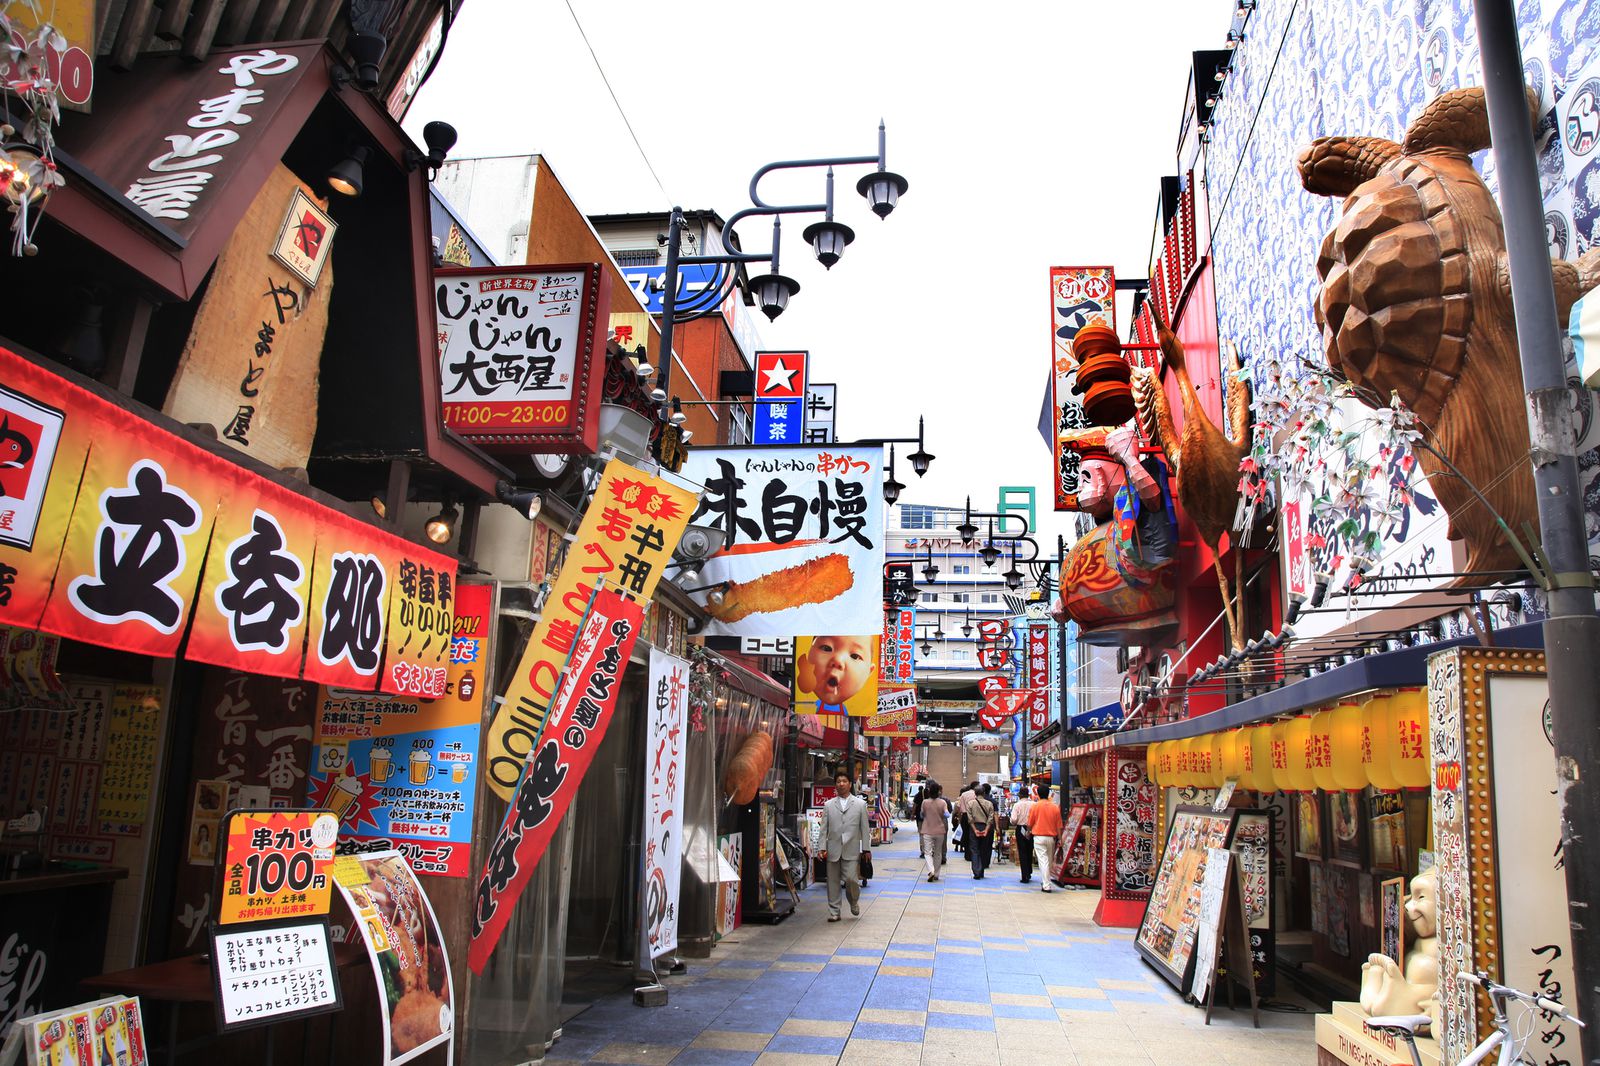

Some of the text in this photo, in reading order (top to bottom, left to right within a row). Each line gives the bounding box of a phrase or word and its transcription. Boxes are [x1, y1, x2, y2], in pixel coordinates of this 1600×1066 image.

[124, 50, 299, 220] やまと屋
[481, 279, 535, 292] 新世界名物
[538, 289, 580, 303] どて焼き
[542, 275, 577, 288] 串かつ
[436, 281, 529, 320] じゃん
[546, 304, 571, 315] 一品
[469, 317, 562, 352] じゃん
[615, 326, 633, 344] 界
[222, 277, 299, 446] やまと屋
[769, 404, 788, 440] 喫茶
[747, 638, 794, 651] コーヒ
[899, 611, 913, 682] 日本一の串
[393, 662, 447, 696] やまと屋
[462, 678, 473, 695] 一合
[321, 725, 372, 736] 無料サービス
[373, 737, 395, 748] 400
[412, 739, 434, 749] 400
[1398, 720, 1410, 759] ハイボール
[1410, 720, 1425, 759] トリス
[439, 752, 471, 761] 無料サービス
[446, 742, 462, 750] 一杯
[1274, 741, 1283, 769] トリス
[1313, 735, 1324, 768] トリス
[380, 799, 465, 811] お一人で二杯お飲みの方に
[381, 786, 461, 800] 400円の中ジョッキ
[391, 823, 449, 836] 無料サービス
[228, 863, 245, 895] 全品
[246, 852, 314, 894] 100
[312, 874, 326, 889] 円
[413, 860, 448, 872] 5号店
[238, 903, 317, 918] お持ち帰り出来ます
[227, 941, 237, 973] カボチャ
[237, 940, 246, 972] しいたけ
[256, 938, 266, 968] なすび
[275, 936, 285, 966] ちくわ
[232, 983, 243, 1016] ゲソ
[242, 981, 253, 1014] キス
[252, 980, 263, 1012] タコ
[262, 978, 273, 1010] イカ
